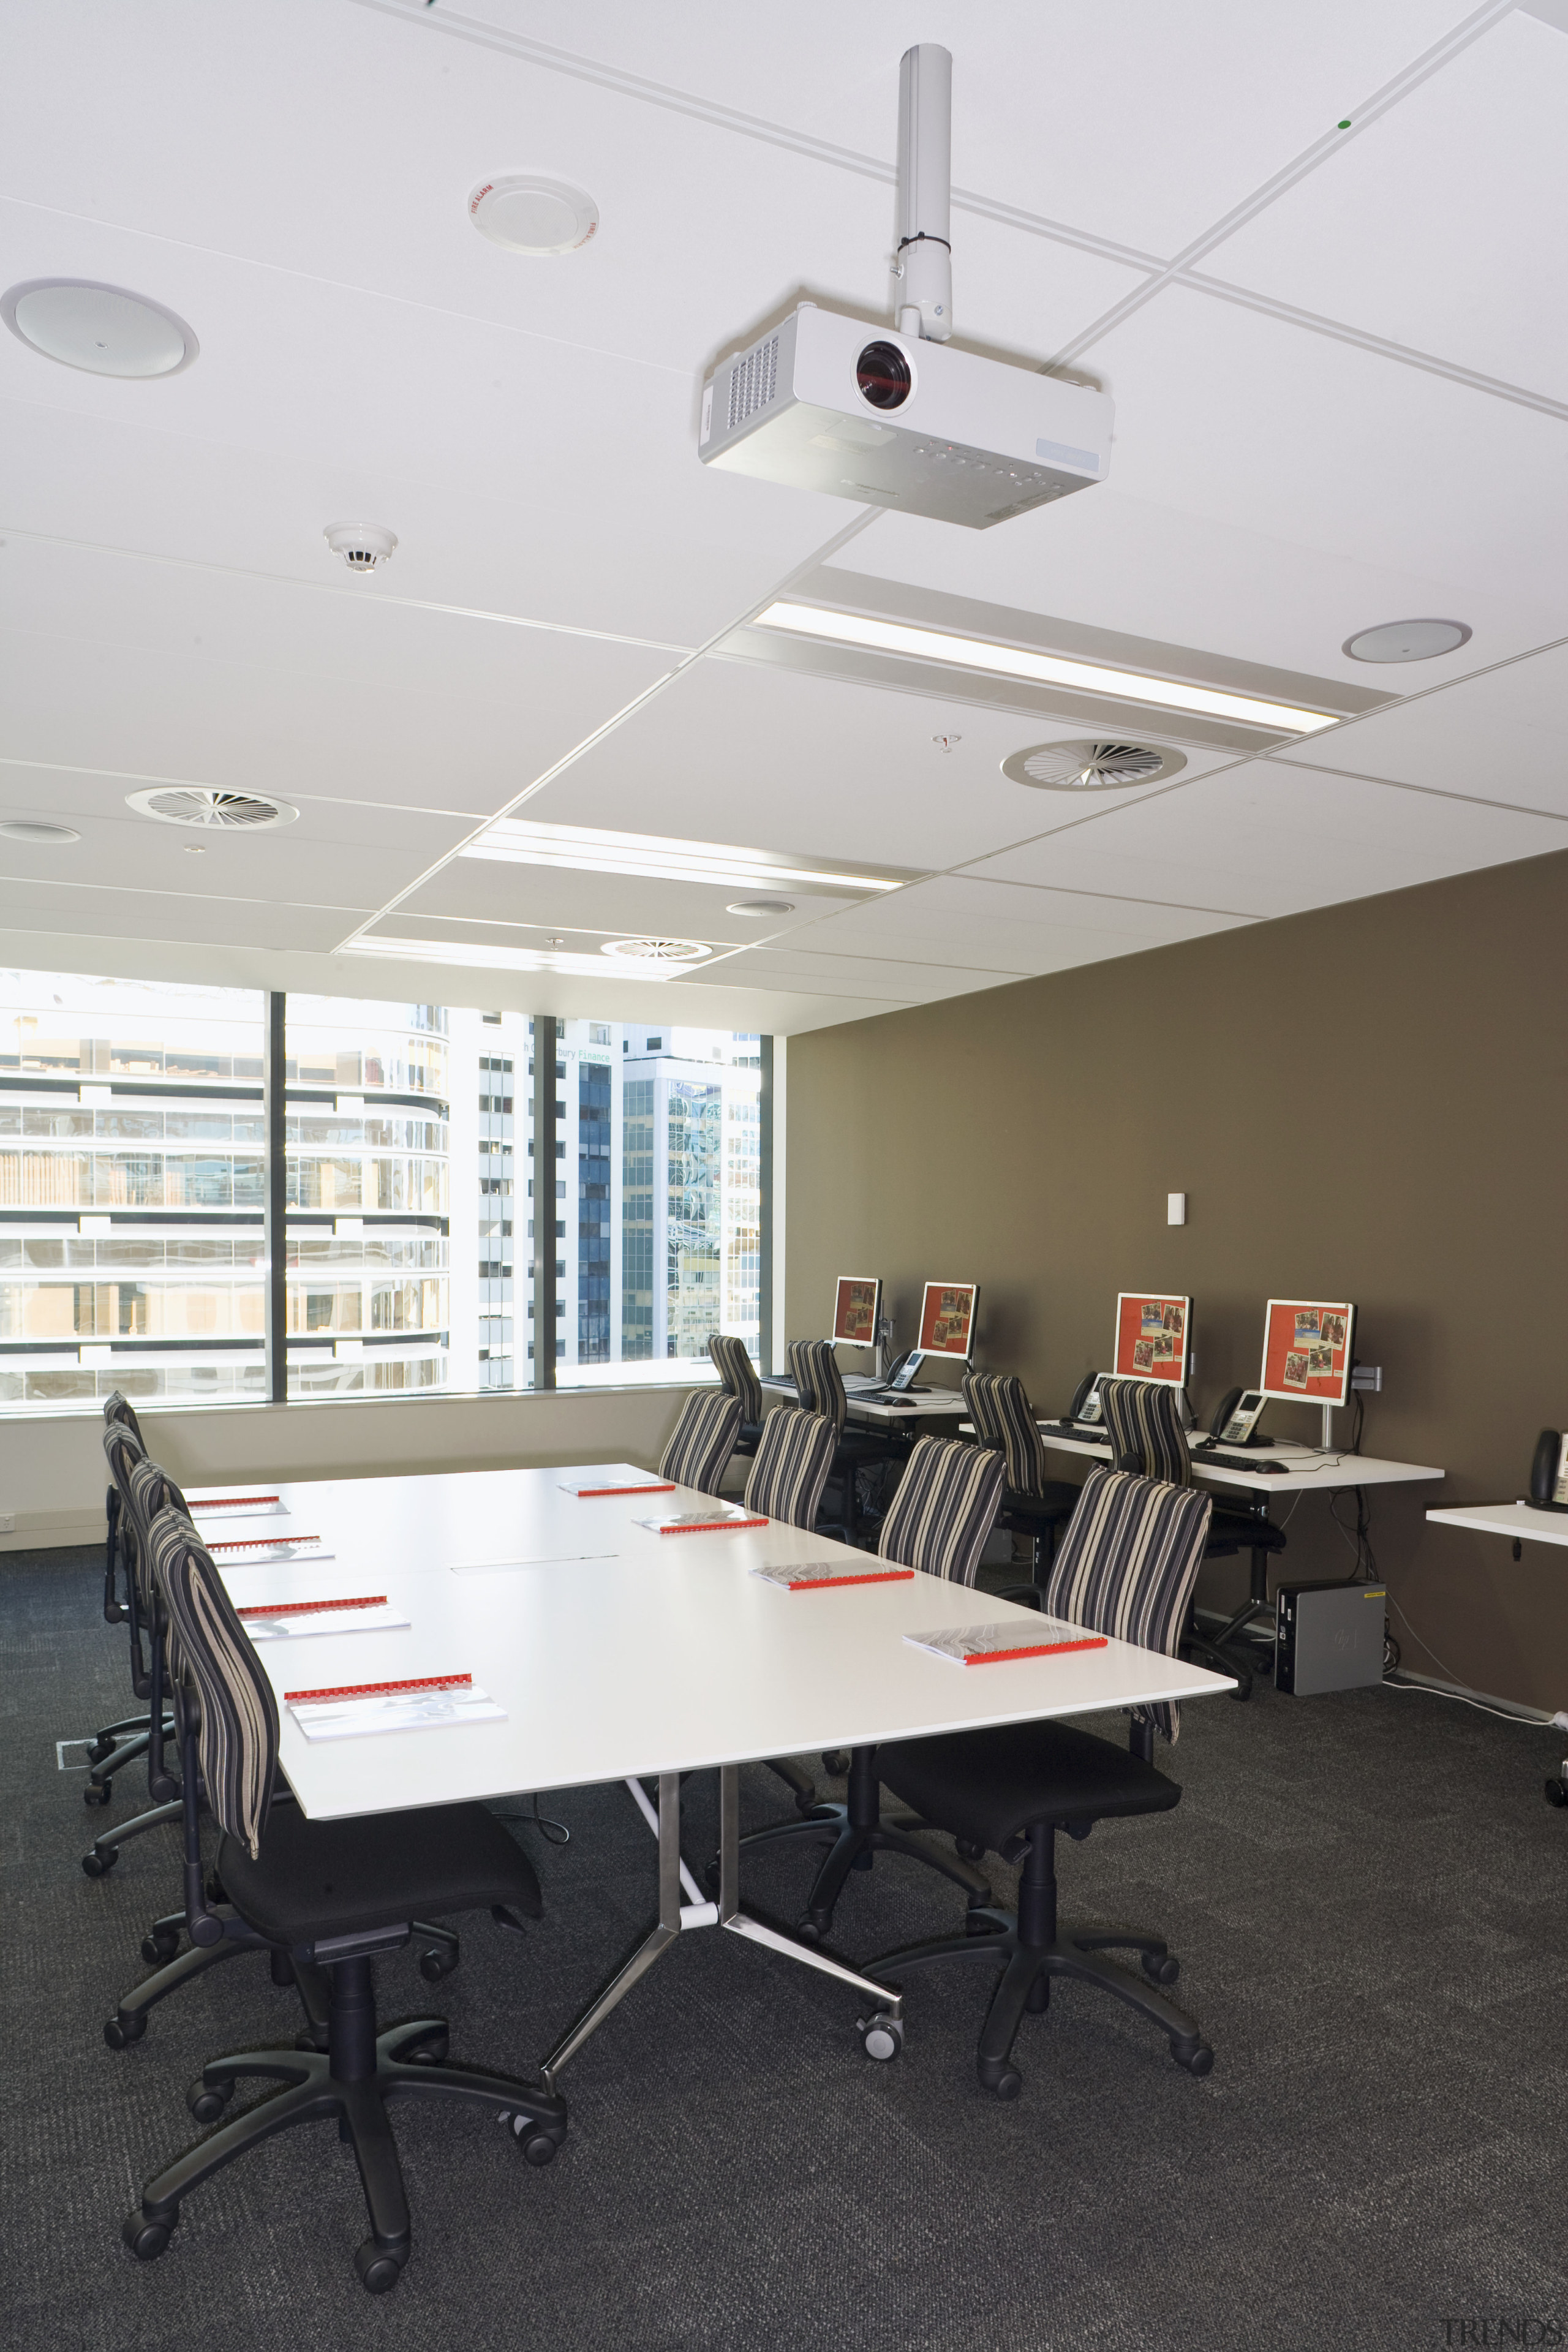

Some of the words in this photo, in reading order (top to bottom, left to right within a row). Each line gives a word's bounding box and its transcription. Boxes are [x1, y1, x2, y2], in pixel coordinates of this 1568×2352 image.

[475, 184, 494, 202] ALARM
[588, 222, 597, 234] FIRE
[579, 1049, 610, 1063] Finance
